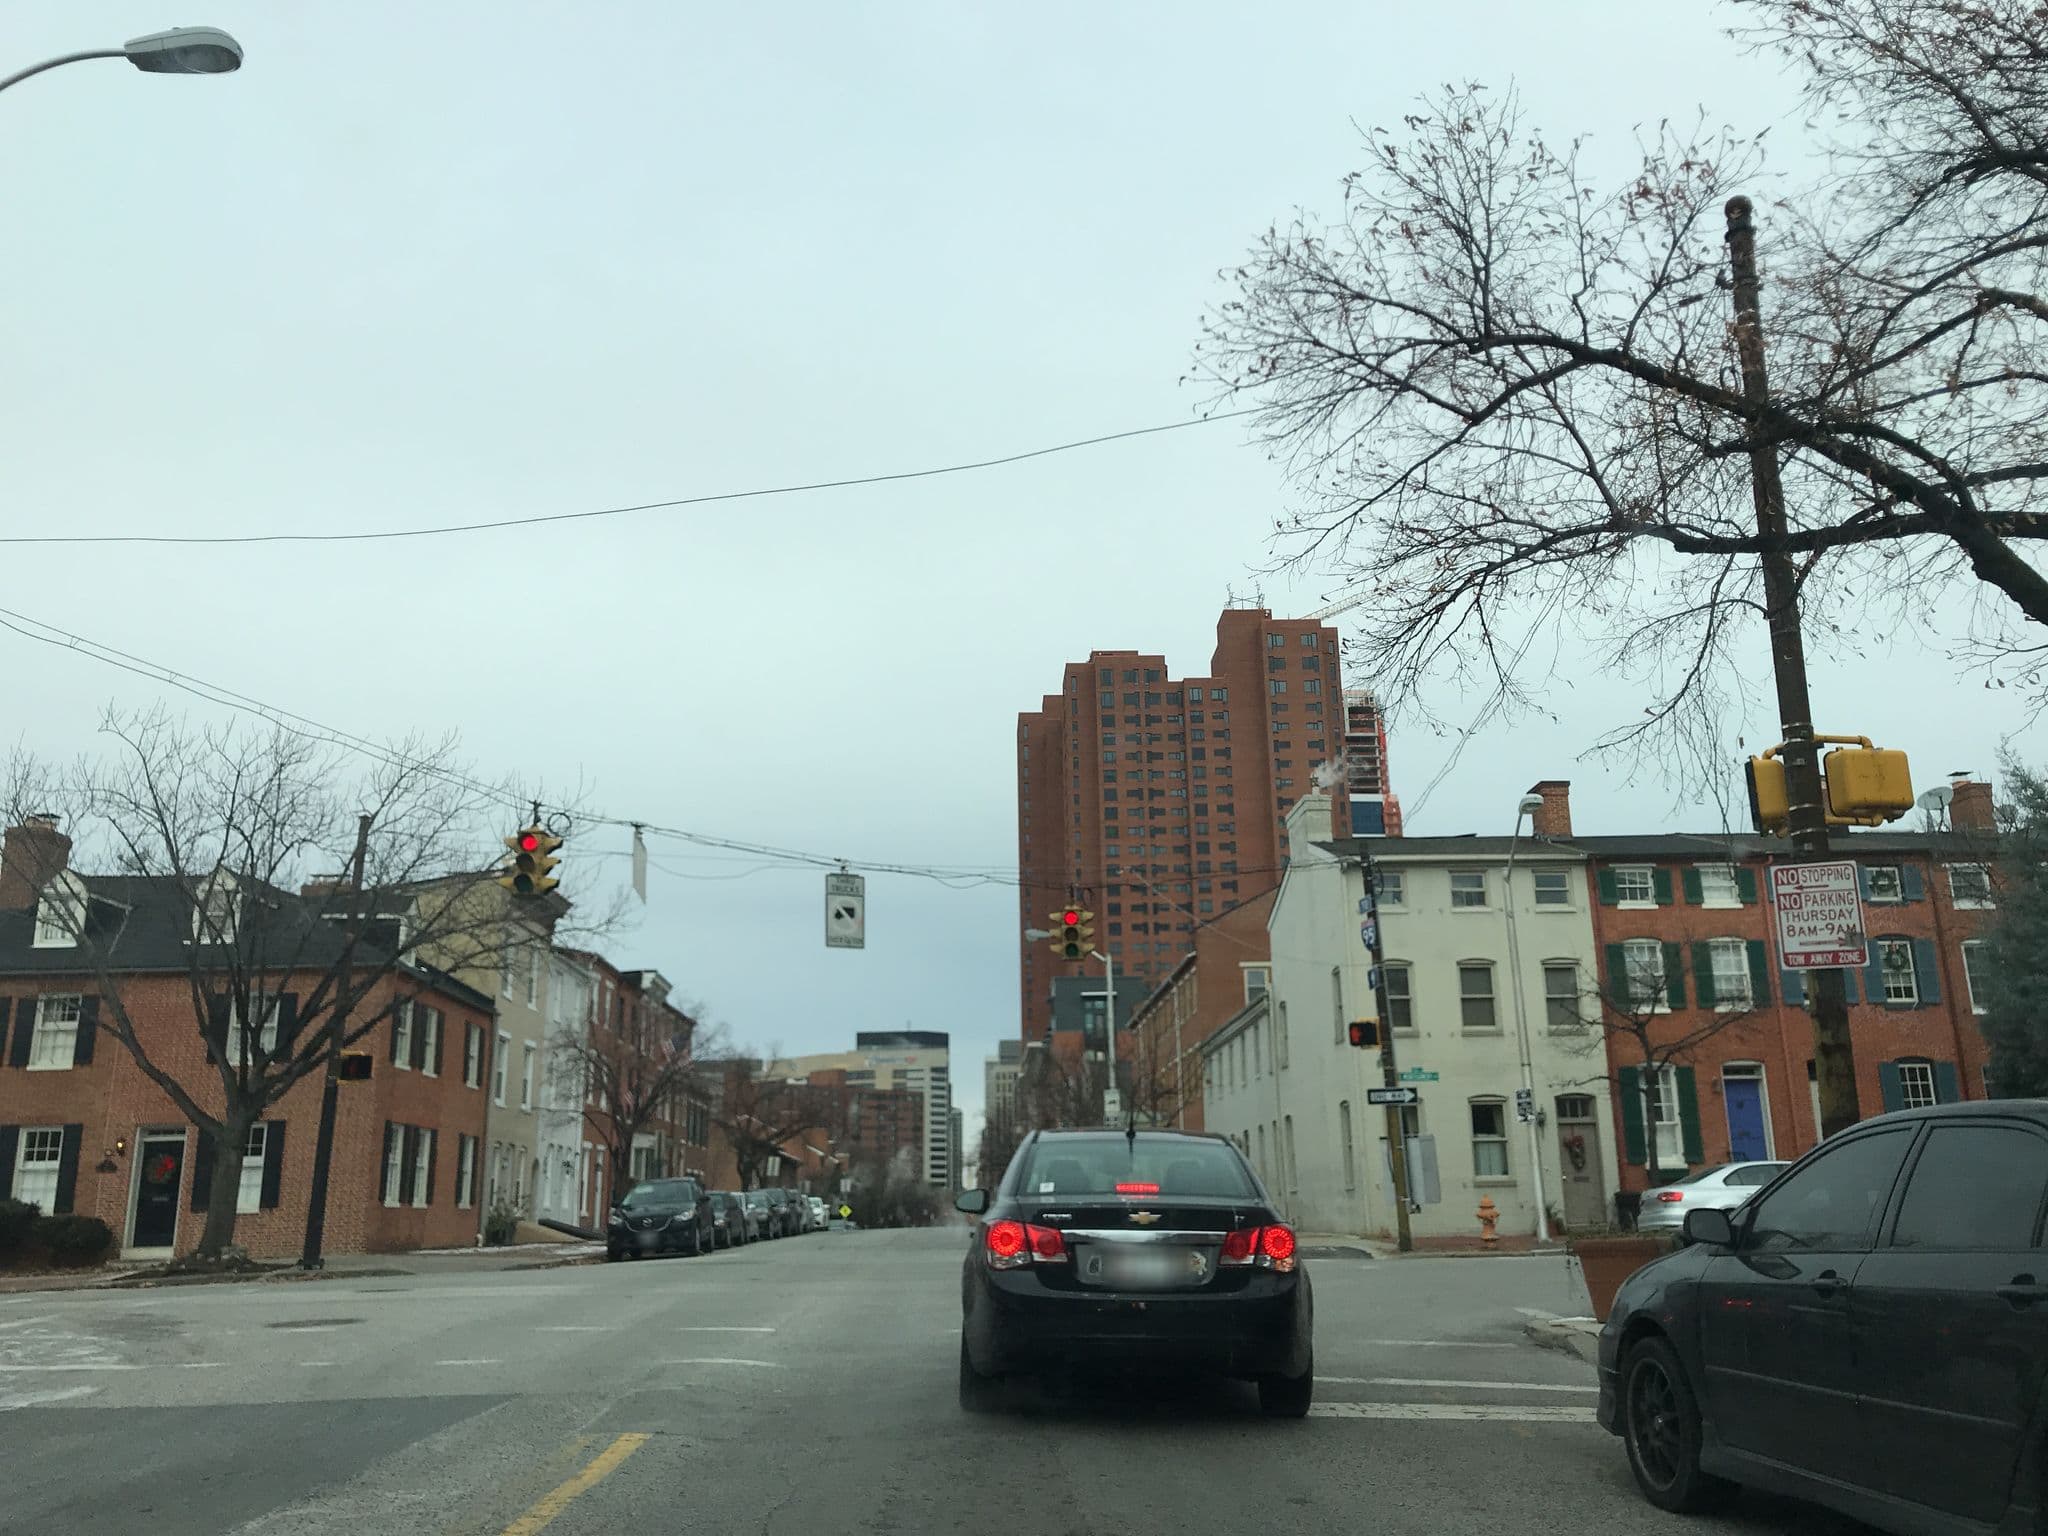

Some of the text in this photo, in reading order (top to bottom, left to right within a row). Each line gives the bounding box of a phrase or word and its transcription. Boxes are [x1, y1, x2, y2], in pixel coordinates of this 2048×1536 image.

[1777, 867, 1851, 885] NO STOPPING
[1780, 891, 1855, 909] NO PARKING
[1784, 908, 1854, 923] THURSDAY
[1362, 927, 1376, 945] 95
[1786, 922, 1857, 938] 8AM-9AM
[1787, 951, 1861, 965] TOW AWAY ZONE
